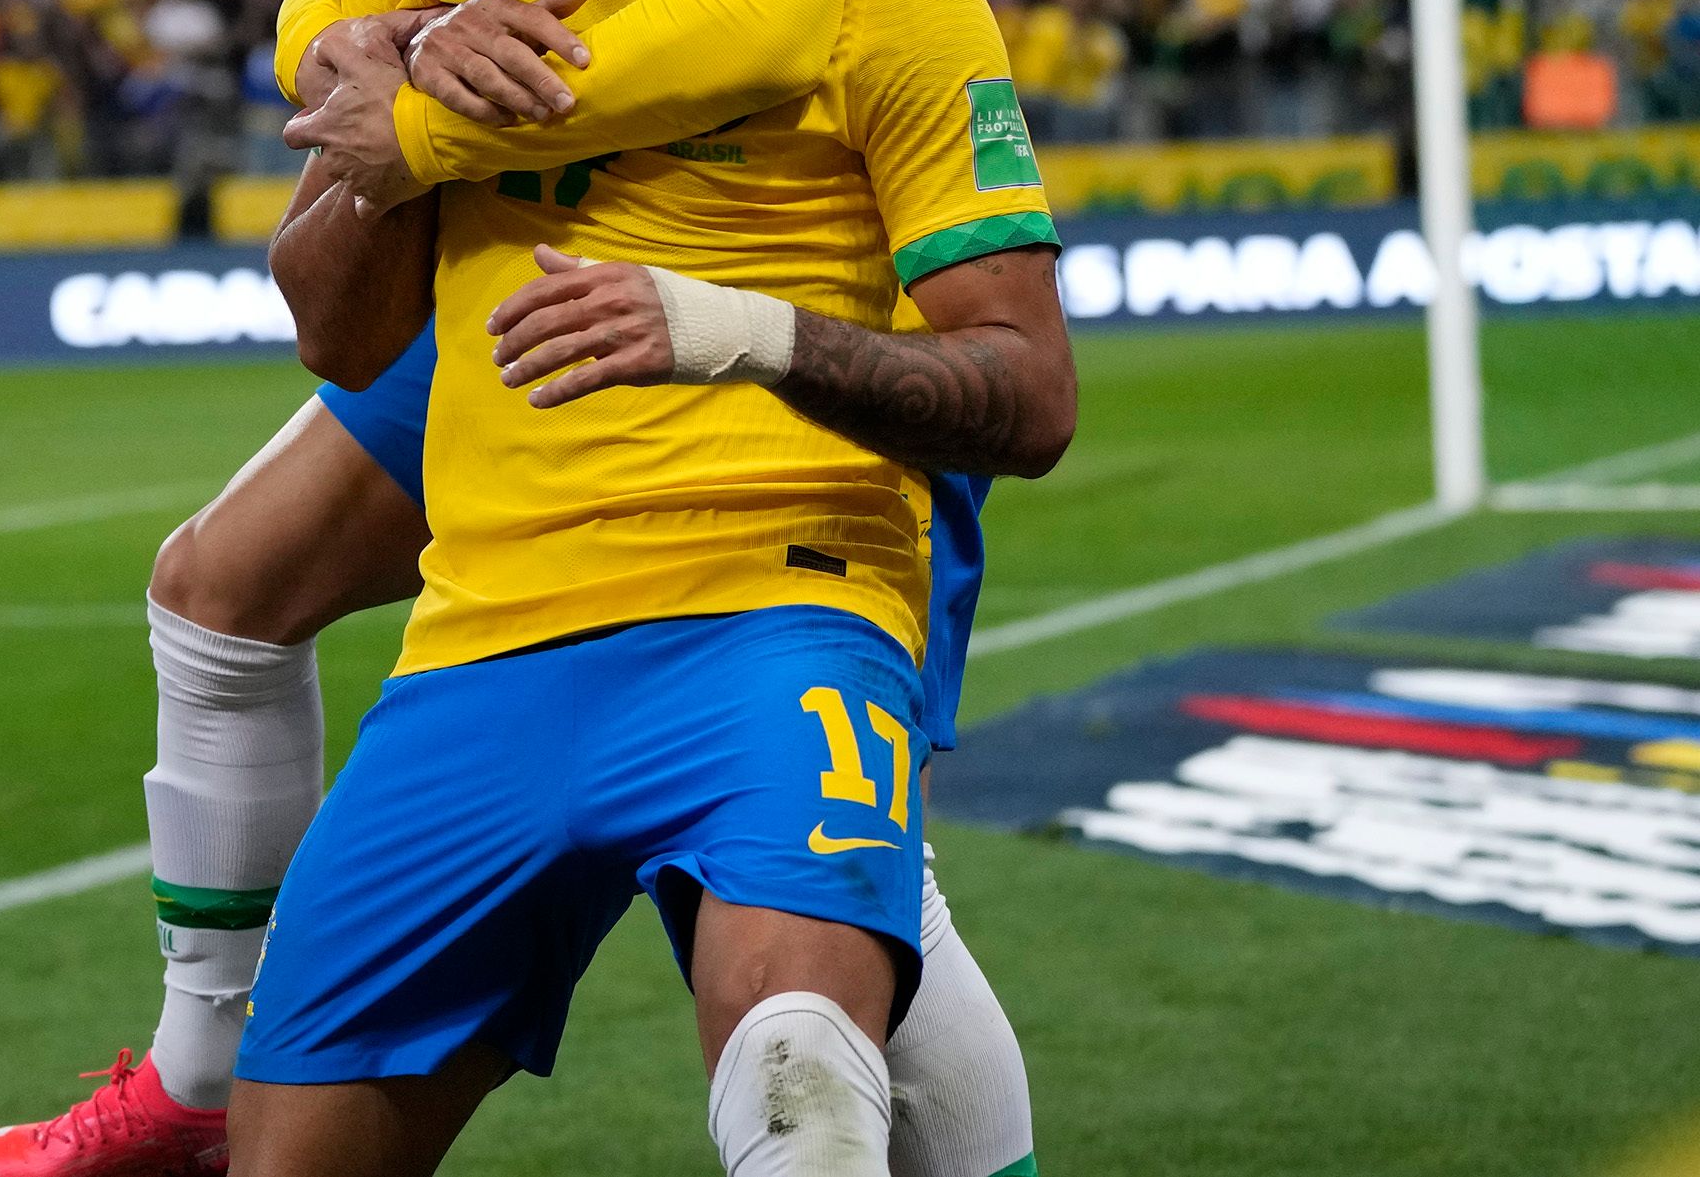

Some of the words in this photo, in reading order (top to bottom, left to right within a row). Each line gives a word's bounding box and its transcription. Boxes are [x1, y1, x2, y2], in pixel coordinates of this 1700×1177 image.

[668, 141, 747, 165] BRASIL
[1125, 232, 1363, 315] PARA
[800, 686, 910, 833] 17
